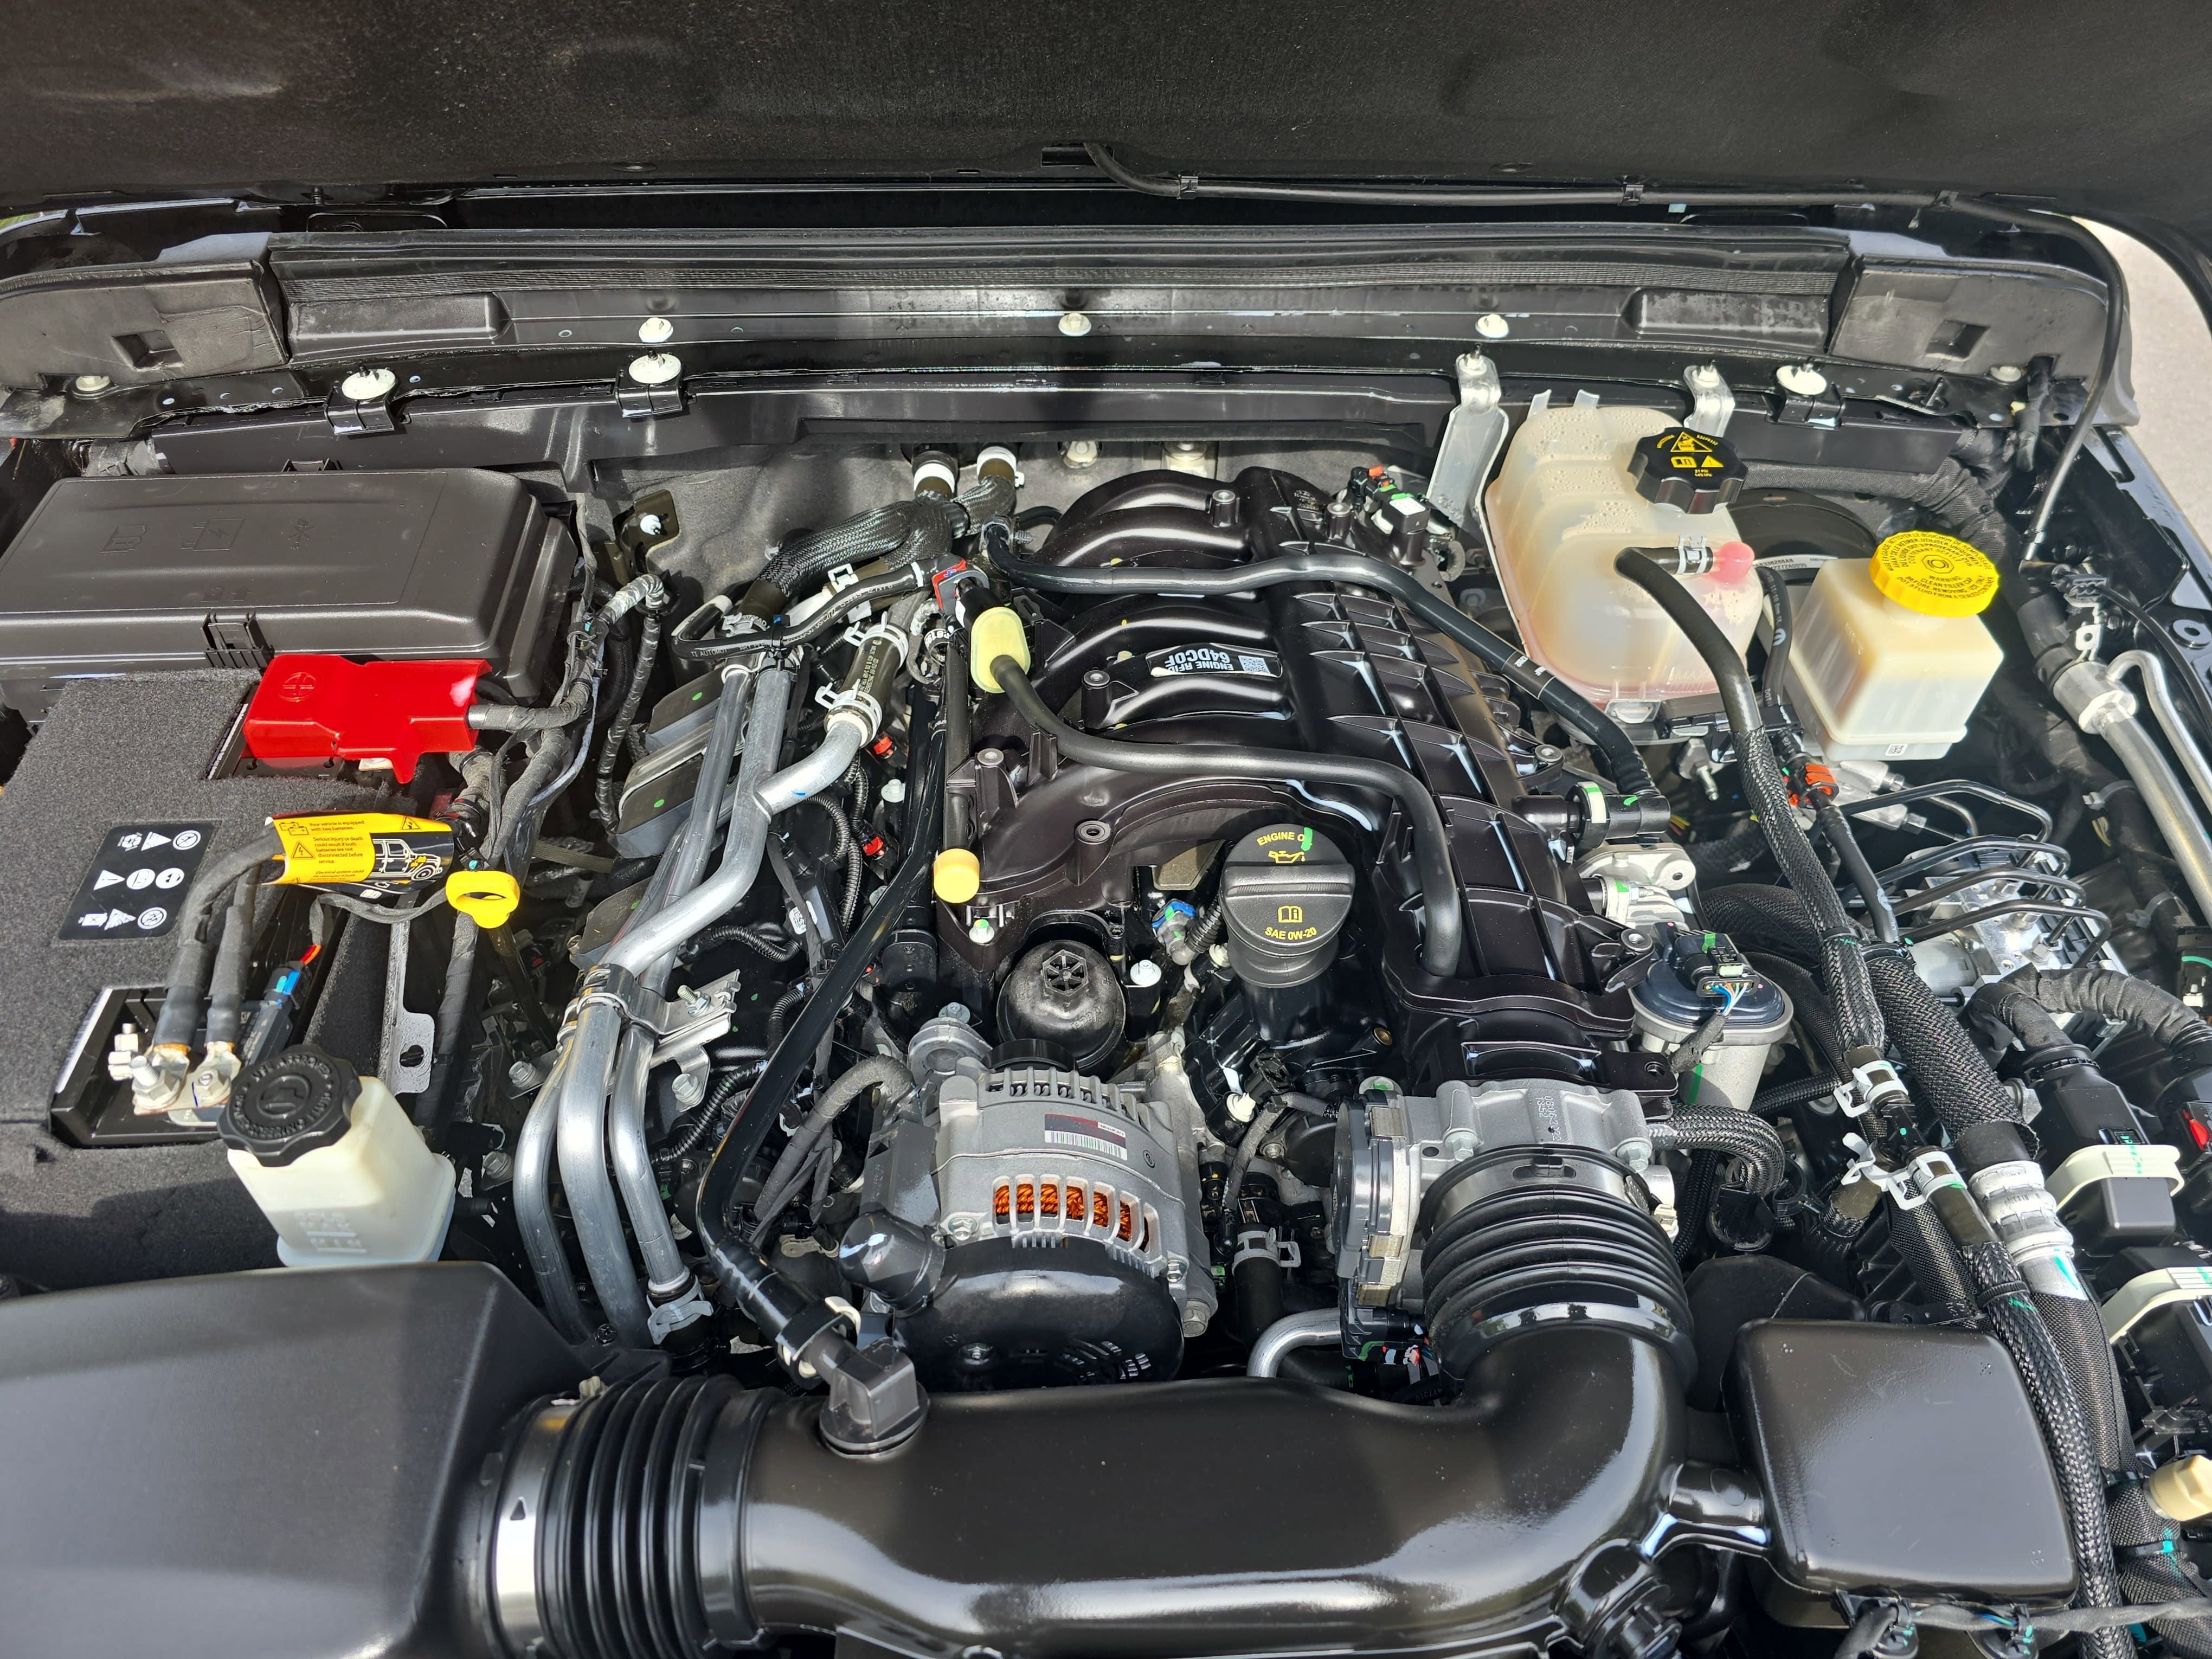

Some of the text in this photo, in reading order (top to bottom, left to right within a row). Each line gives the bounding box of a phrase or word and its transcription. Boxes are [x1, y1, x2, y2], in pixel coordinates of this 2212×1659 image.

[1895, 576, 1909, 584] DOT
[1912, 585, 1932, 595] FLUID
[1975, 576, 1995, 594] CONTAINER
[1905, 576, 1930, 589] BEFORE
[1919, 578, 1943, 587] CLEAN
[1166, 661, 1234, 673] ENGINE RFID
[1257, 832, 1295, 846] ENGINE
[1264, 927, 1317, 941] SAE 0W-20
